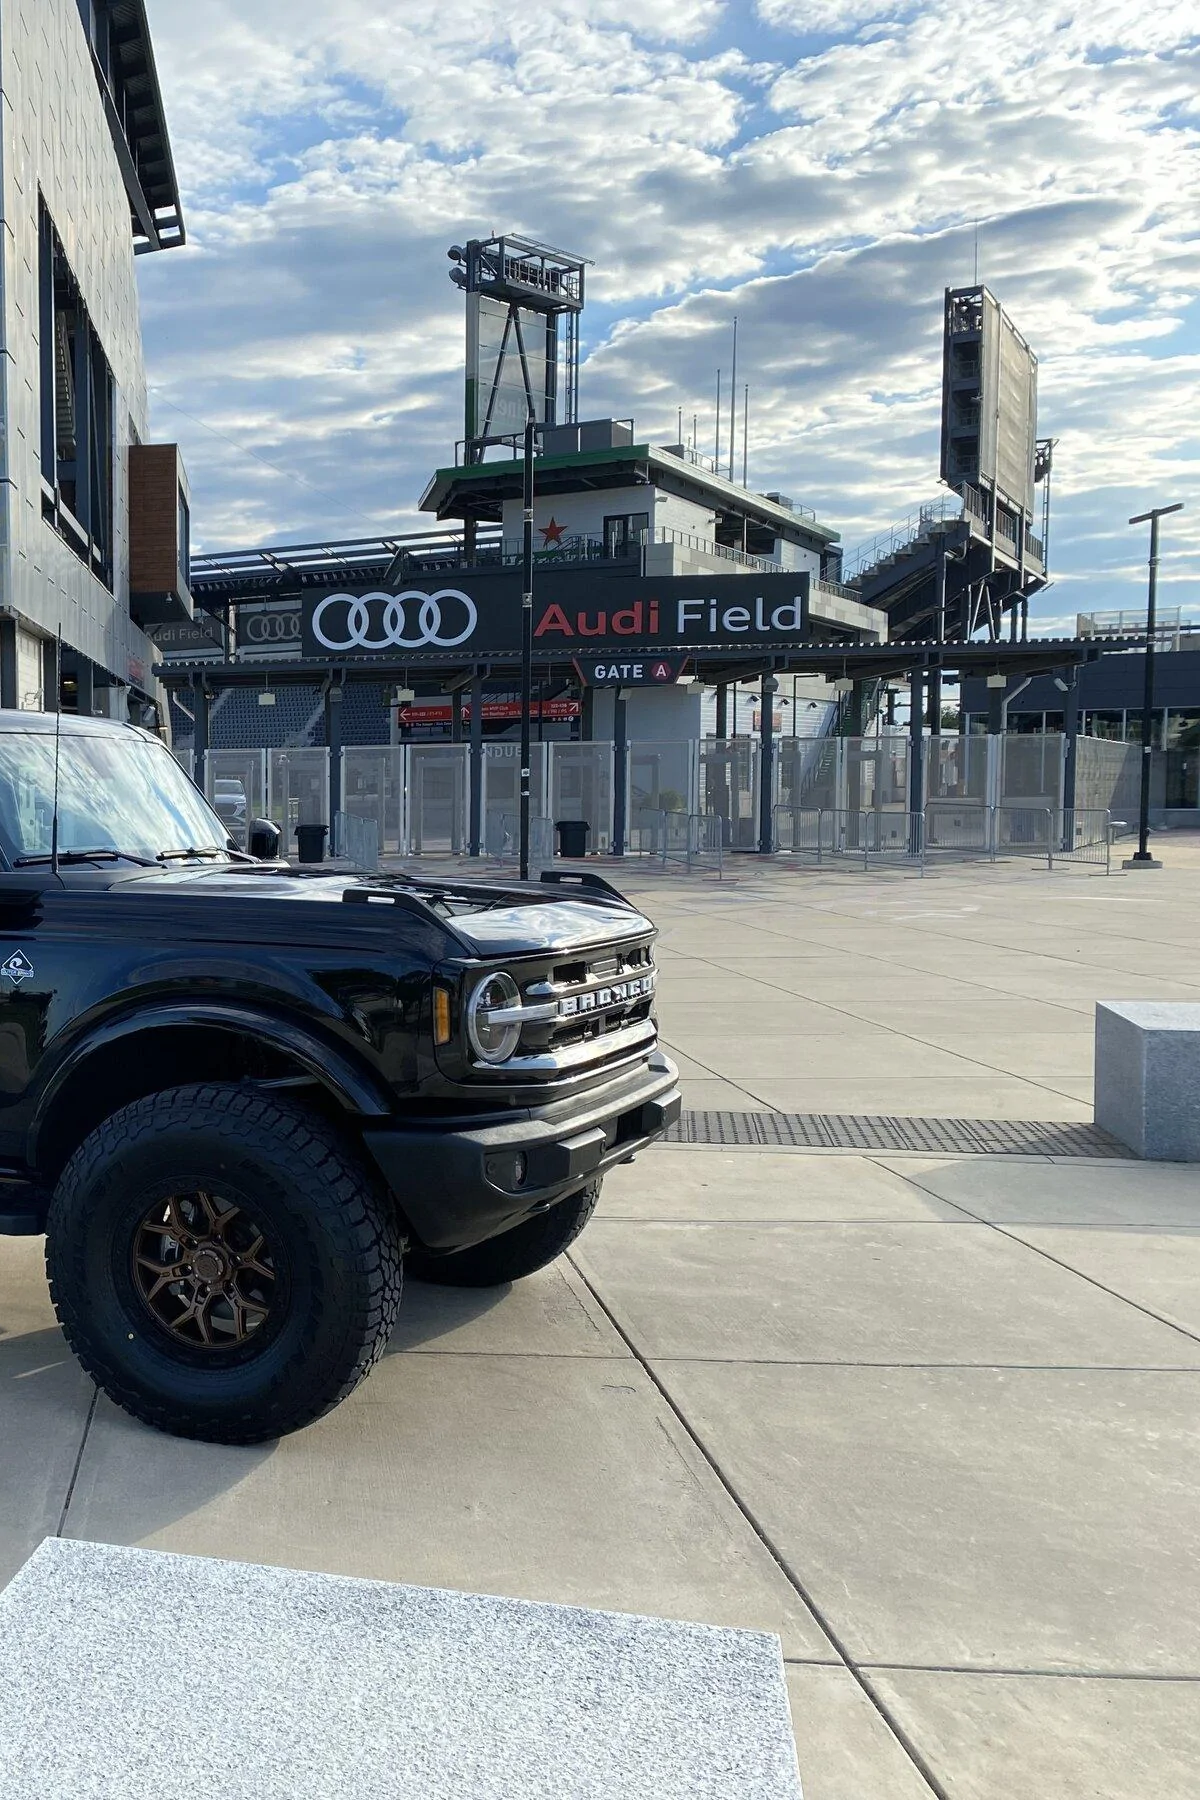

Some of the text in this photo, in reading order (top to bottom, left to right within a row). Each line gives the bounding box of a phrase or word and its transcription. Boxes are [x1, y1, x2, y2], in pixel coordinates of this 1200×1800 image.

[534, 596, 802, 637] Audi Field
[179, 626, 213, 641] Field
[594, 664, 667, 679] GATE A
[560, 977, 653, 1016] BRONCO
